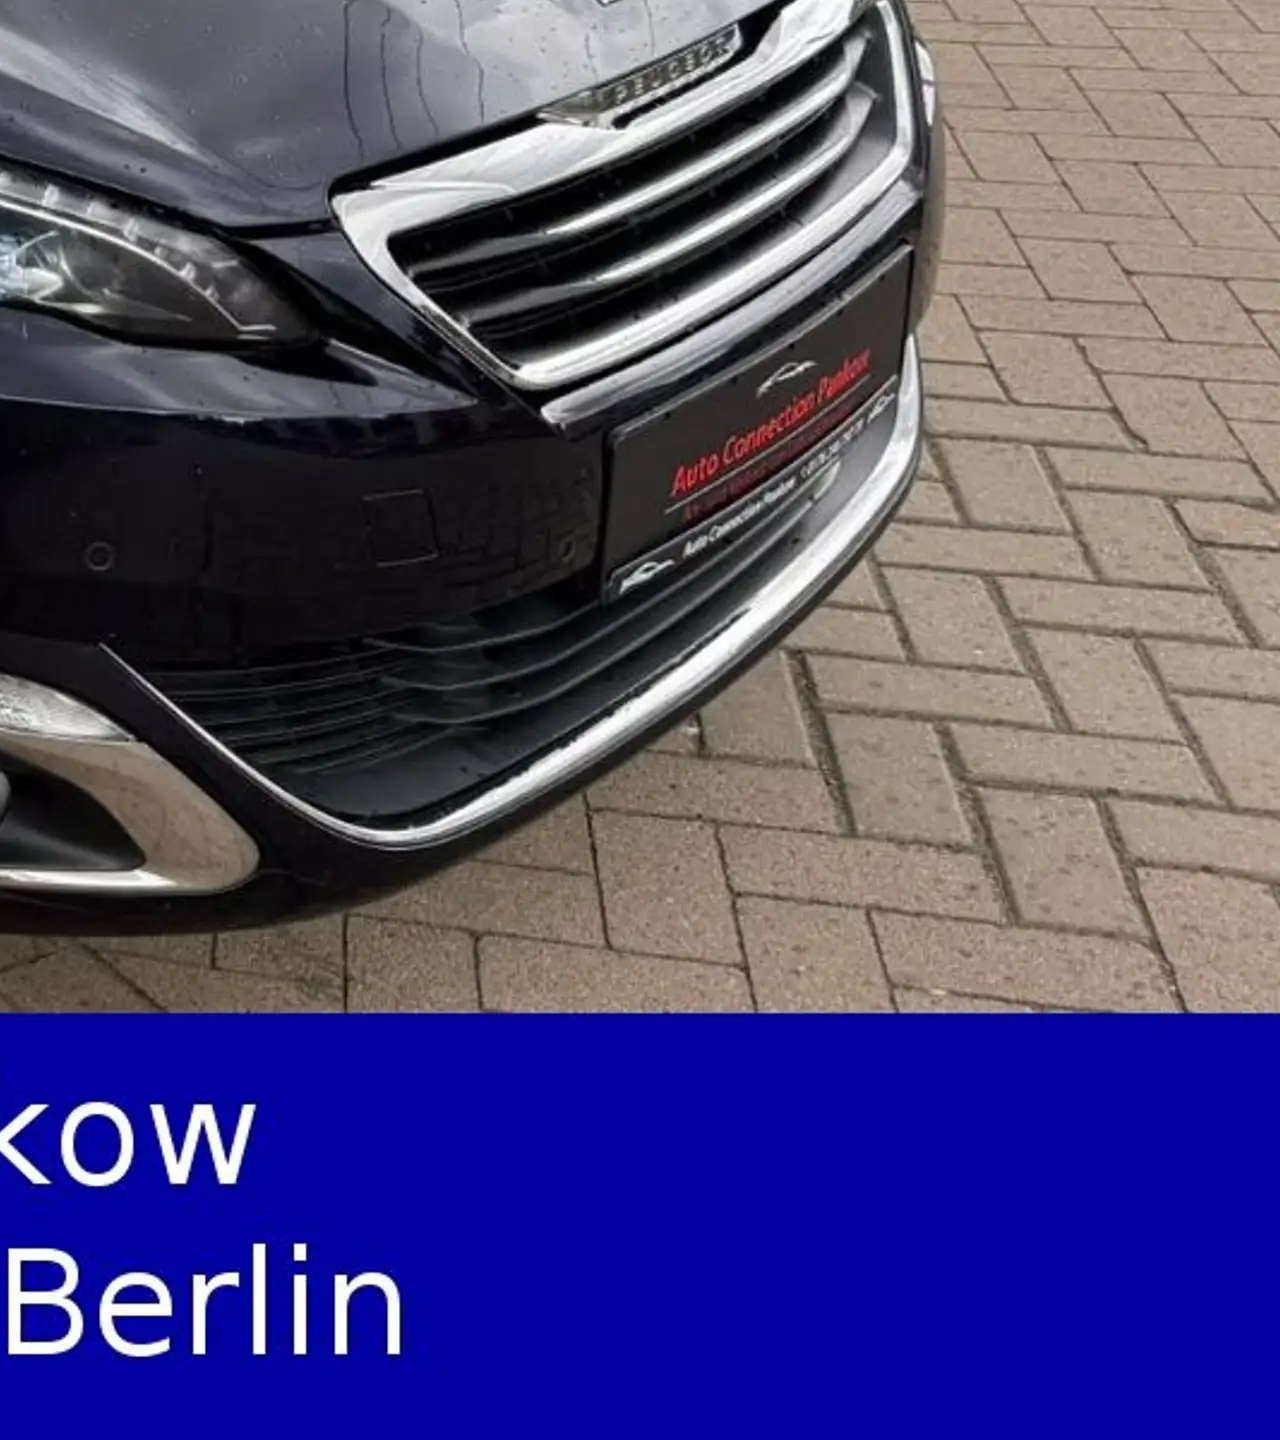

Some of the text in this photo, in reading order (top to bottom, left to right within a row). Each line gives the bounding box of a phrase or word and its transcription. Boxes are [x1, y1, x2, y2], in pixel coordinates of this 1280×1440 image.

[669, 452, 719, 497] Auto
[722, 391, 816, 465] Connection
[816, 348, 872, 404] Pankow
